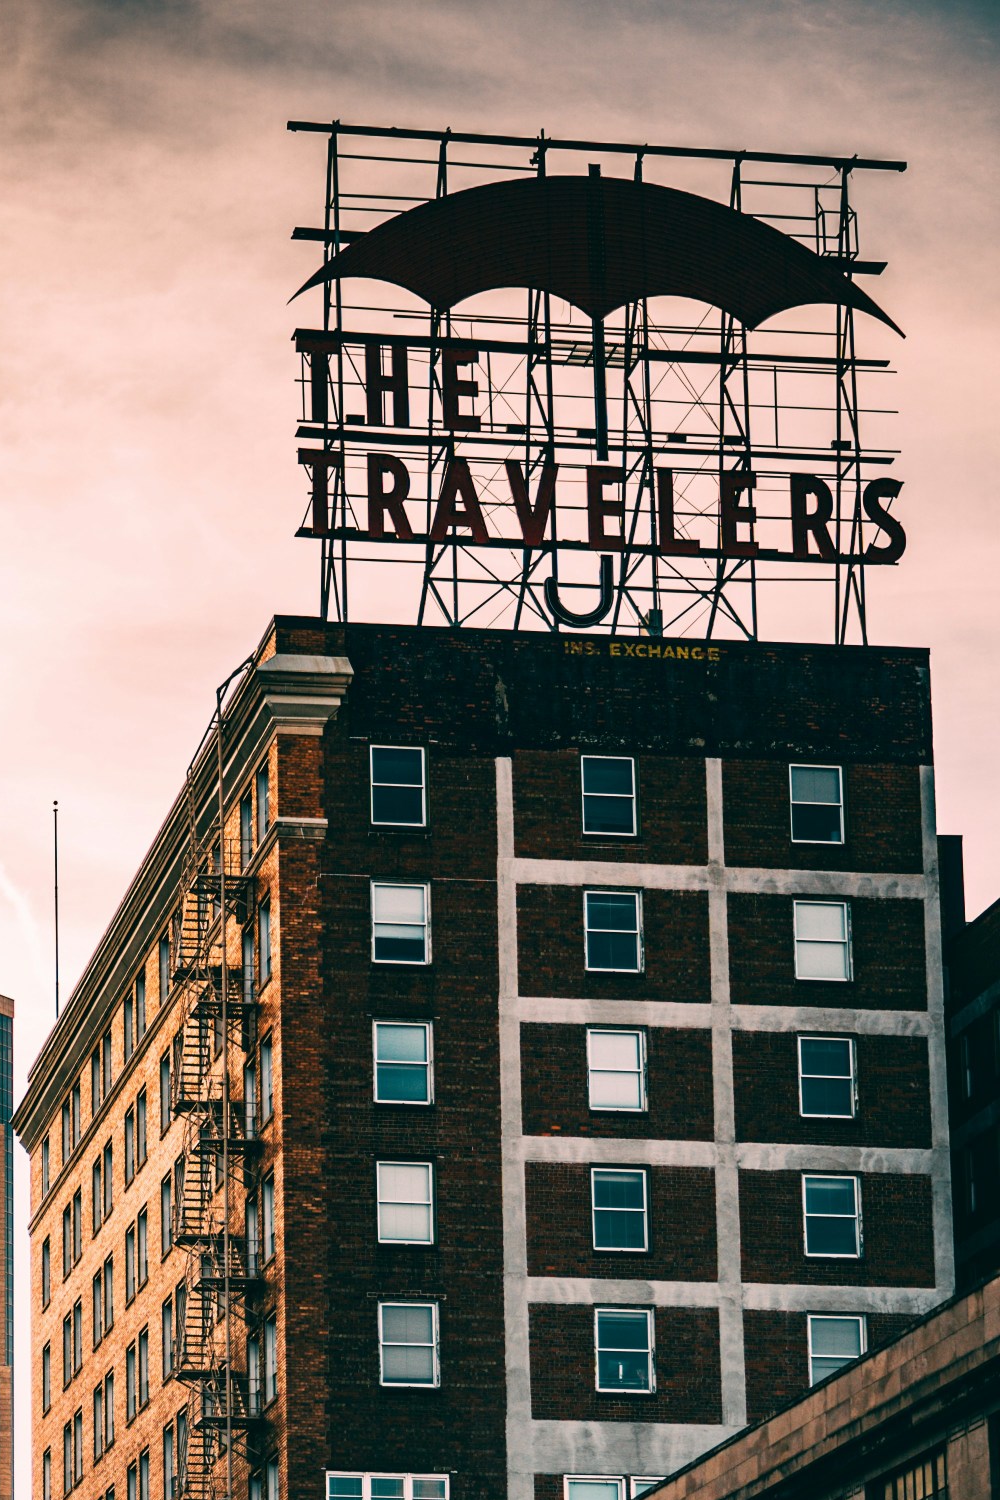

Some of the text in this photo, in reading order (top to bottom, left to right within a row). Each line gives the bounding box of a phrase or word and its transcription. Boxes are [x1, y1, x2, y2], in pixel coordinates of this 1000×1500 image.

[296, 340, 481, 431] THE
[297, 449, 907, 565] TRAVELERS
[609, 642, 721, 661] EXCHANGE
